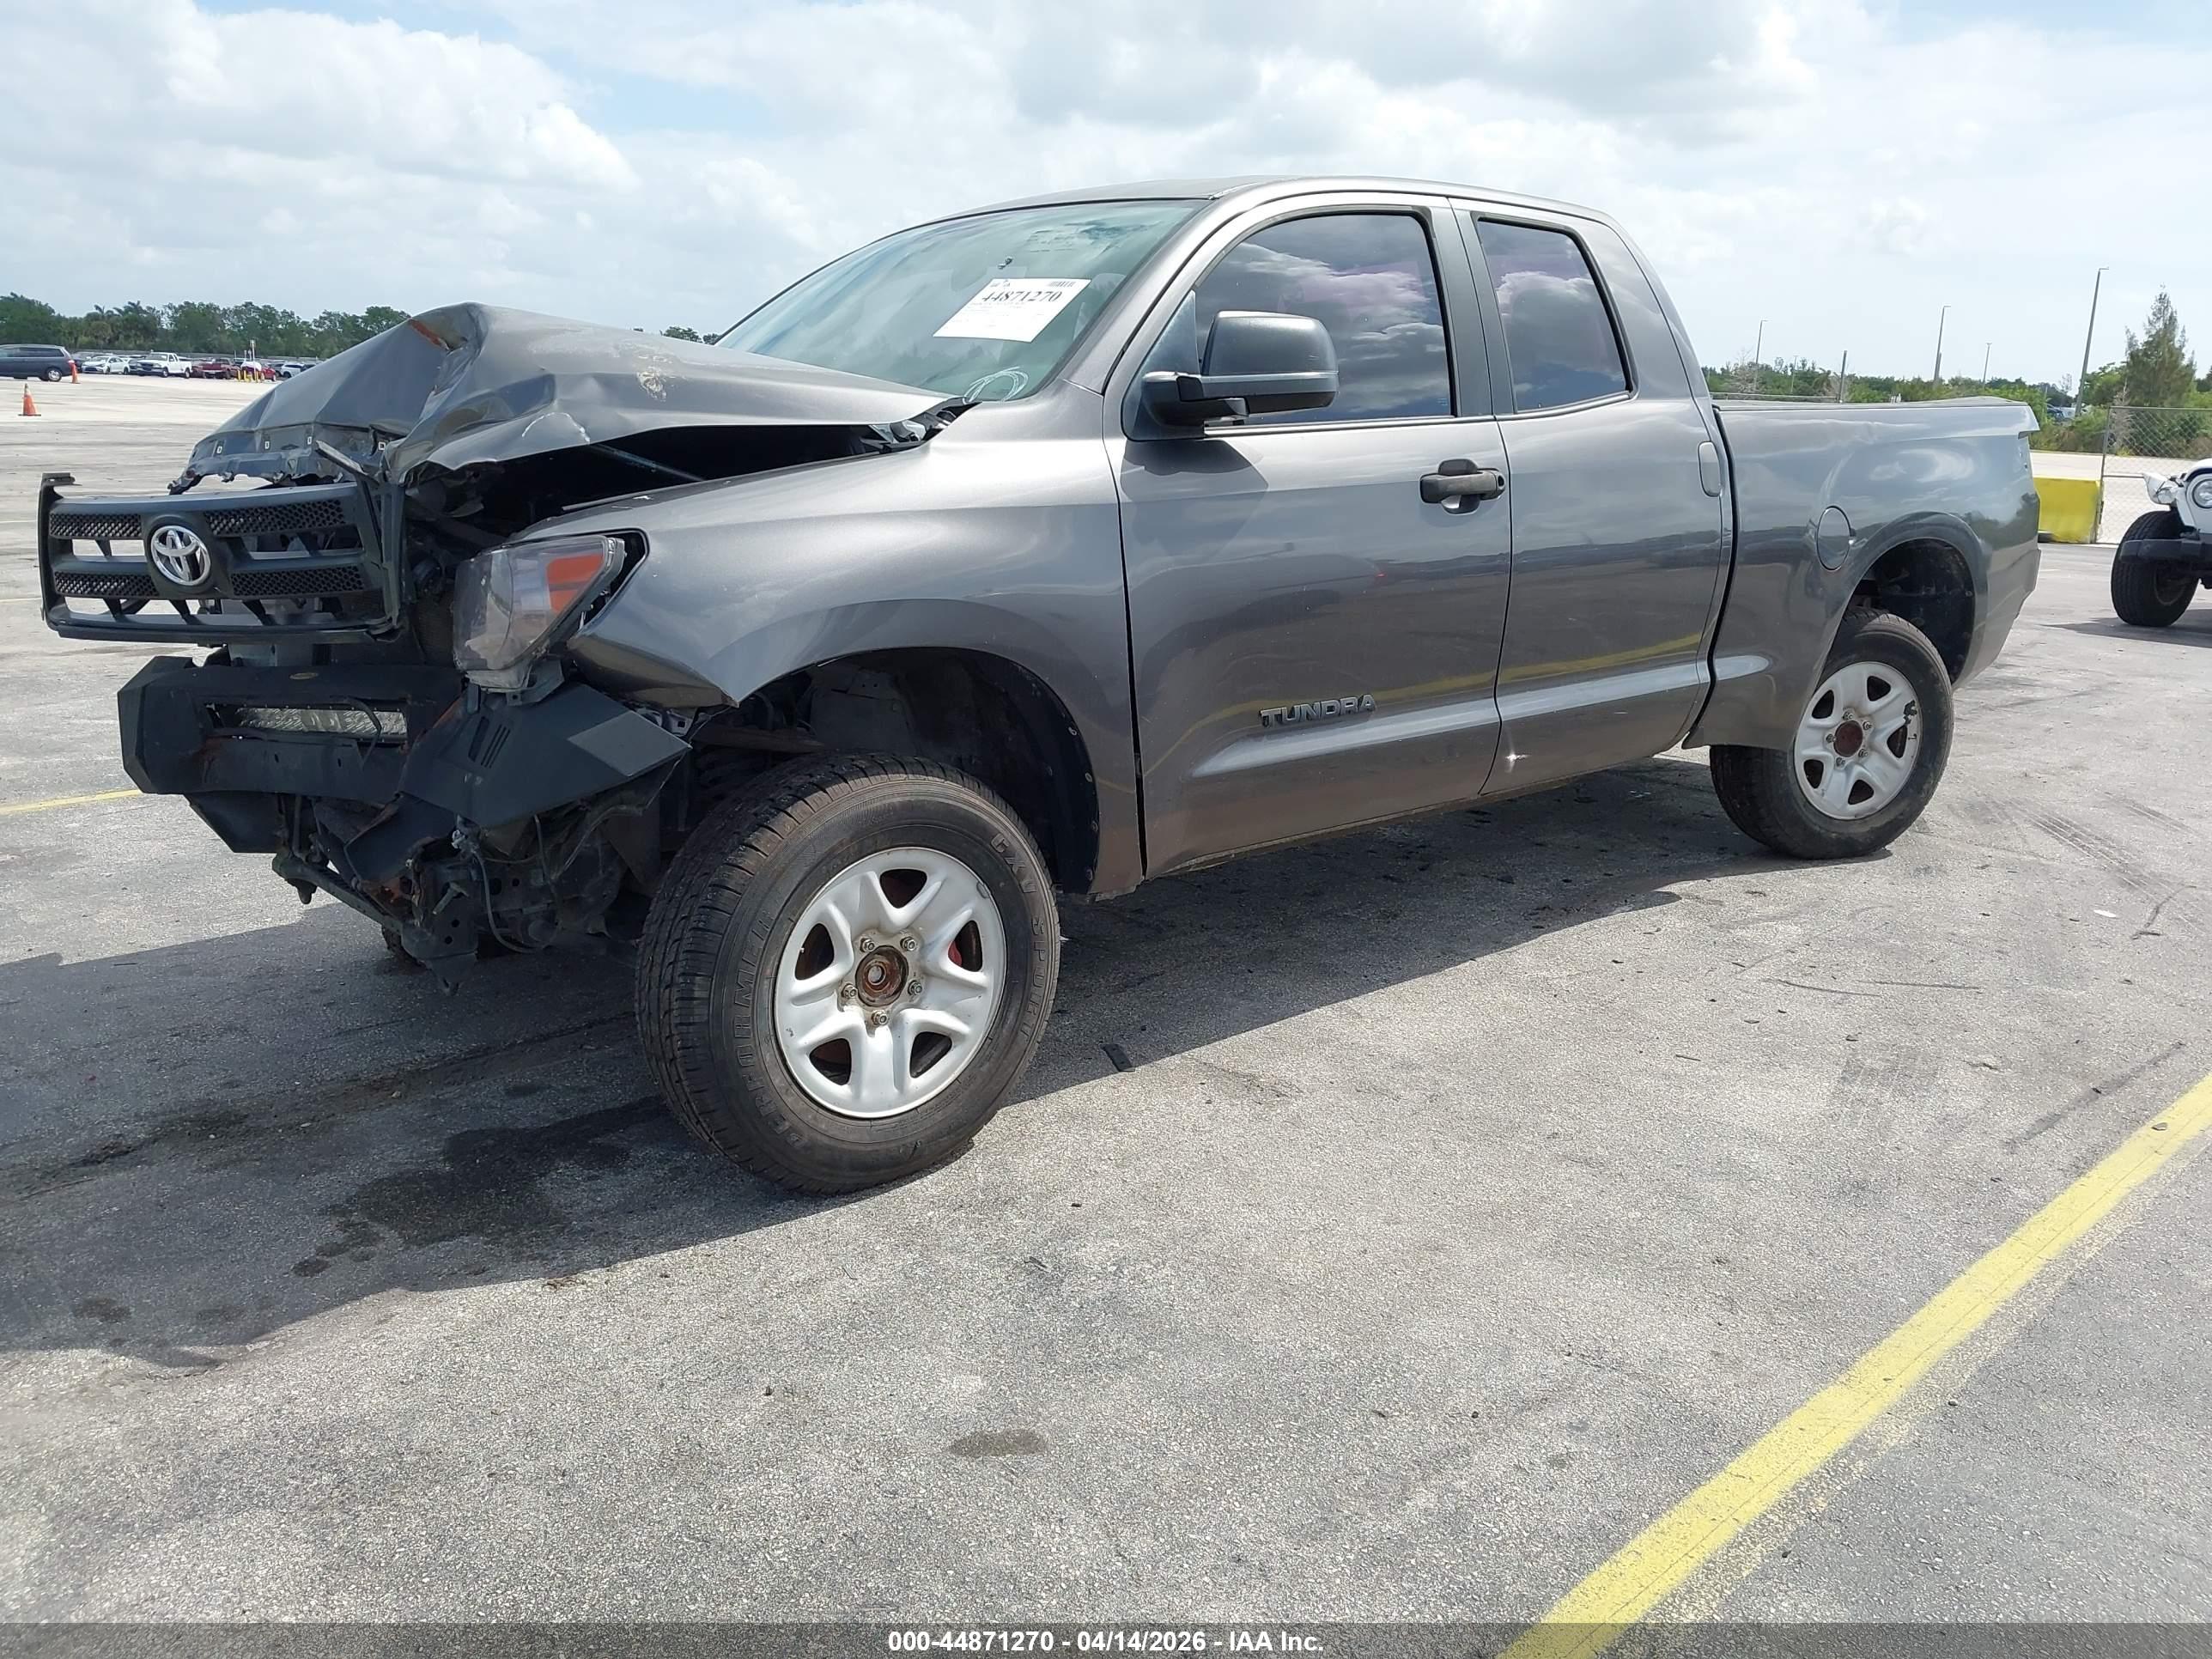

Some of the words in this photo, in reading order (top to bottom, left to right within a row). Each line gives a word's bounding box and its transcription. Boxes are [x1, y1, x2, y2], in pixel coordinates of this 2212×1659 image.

[981, 290, 1063, 302] 44871270
[1259, 693, 1376, 728] TUNDRA
[1019, 915, 1047, 1040] SPORT
[733, 908, 807, 1149] PERFORMER
